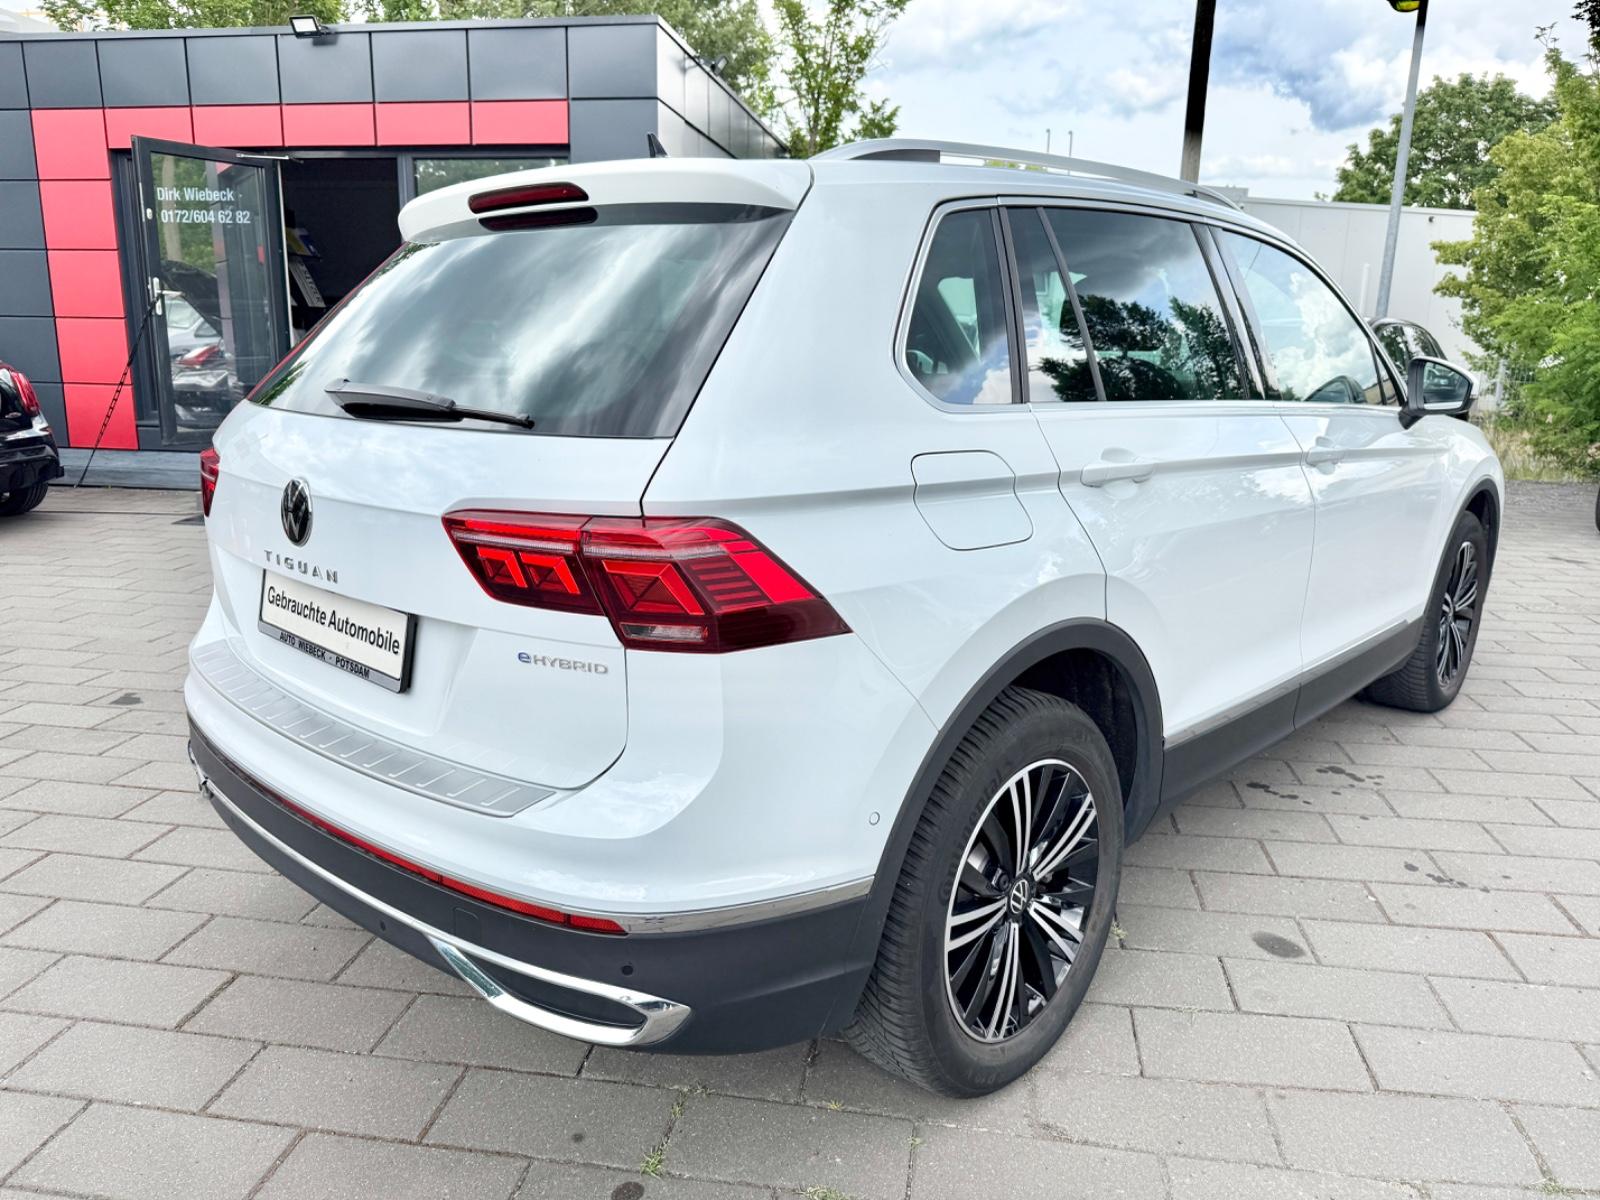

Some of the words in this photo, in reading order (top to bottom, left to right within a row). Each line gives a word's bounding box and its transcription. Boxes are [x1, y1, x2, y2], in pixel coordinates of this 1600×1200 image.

[156, 187, 181, 201] Dirk
[183, 187, 235, 201] Wiebeck
[160, 209, 215, 224] 0172/604
[218, 211, 233, 224] 62
[235, 211, 251, 224] 82
[264, 549, 338, 584] TIGUAN
[267, 586, 327, 626] Gebrauchte
[327, 609, 400, 655] Automobile
[279, 631, 296, 647] AUTO
[298, 640, 326, 661] WIEBECK
[335, 656, 370, 679] POTSDAM
[517, 651, 608, 674] eHYBRID
